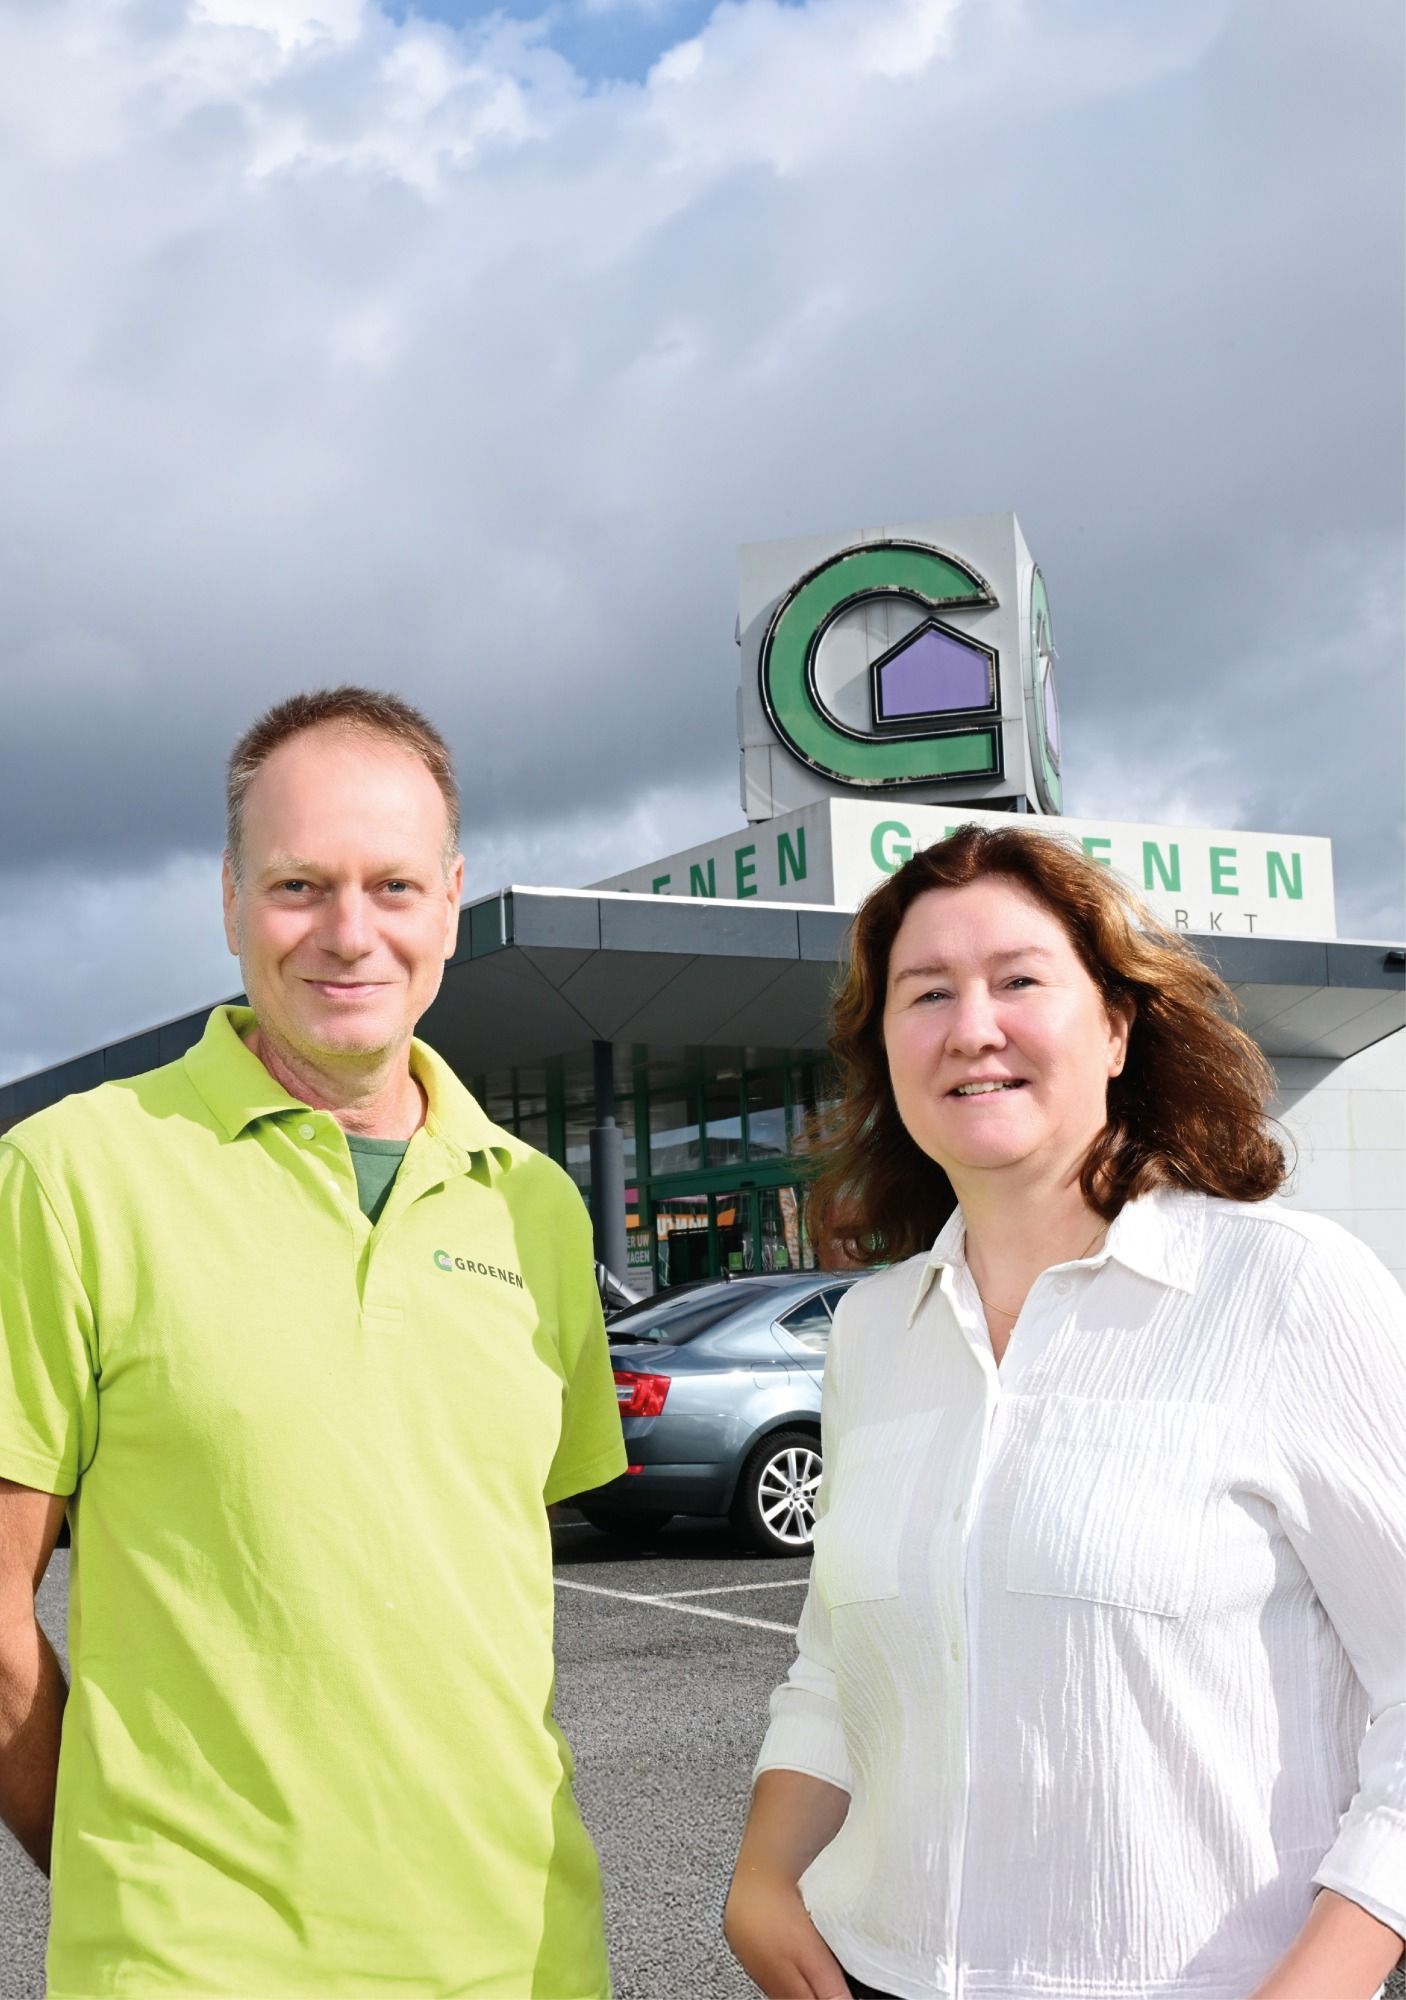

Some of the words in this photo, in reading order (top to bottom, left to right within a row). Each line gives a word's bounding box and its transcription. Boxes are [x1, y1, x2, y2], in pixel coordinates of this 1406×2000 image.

[1175, 909, 1258, 933] RKT
[627, 1250, 650, 1264] AGEN
[454, 1257, 524, 1289] GROENEN
